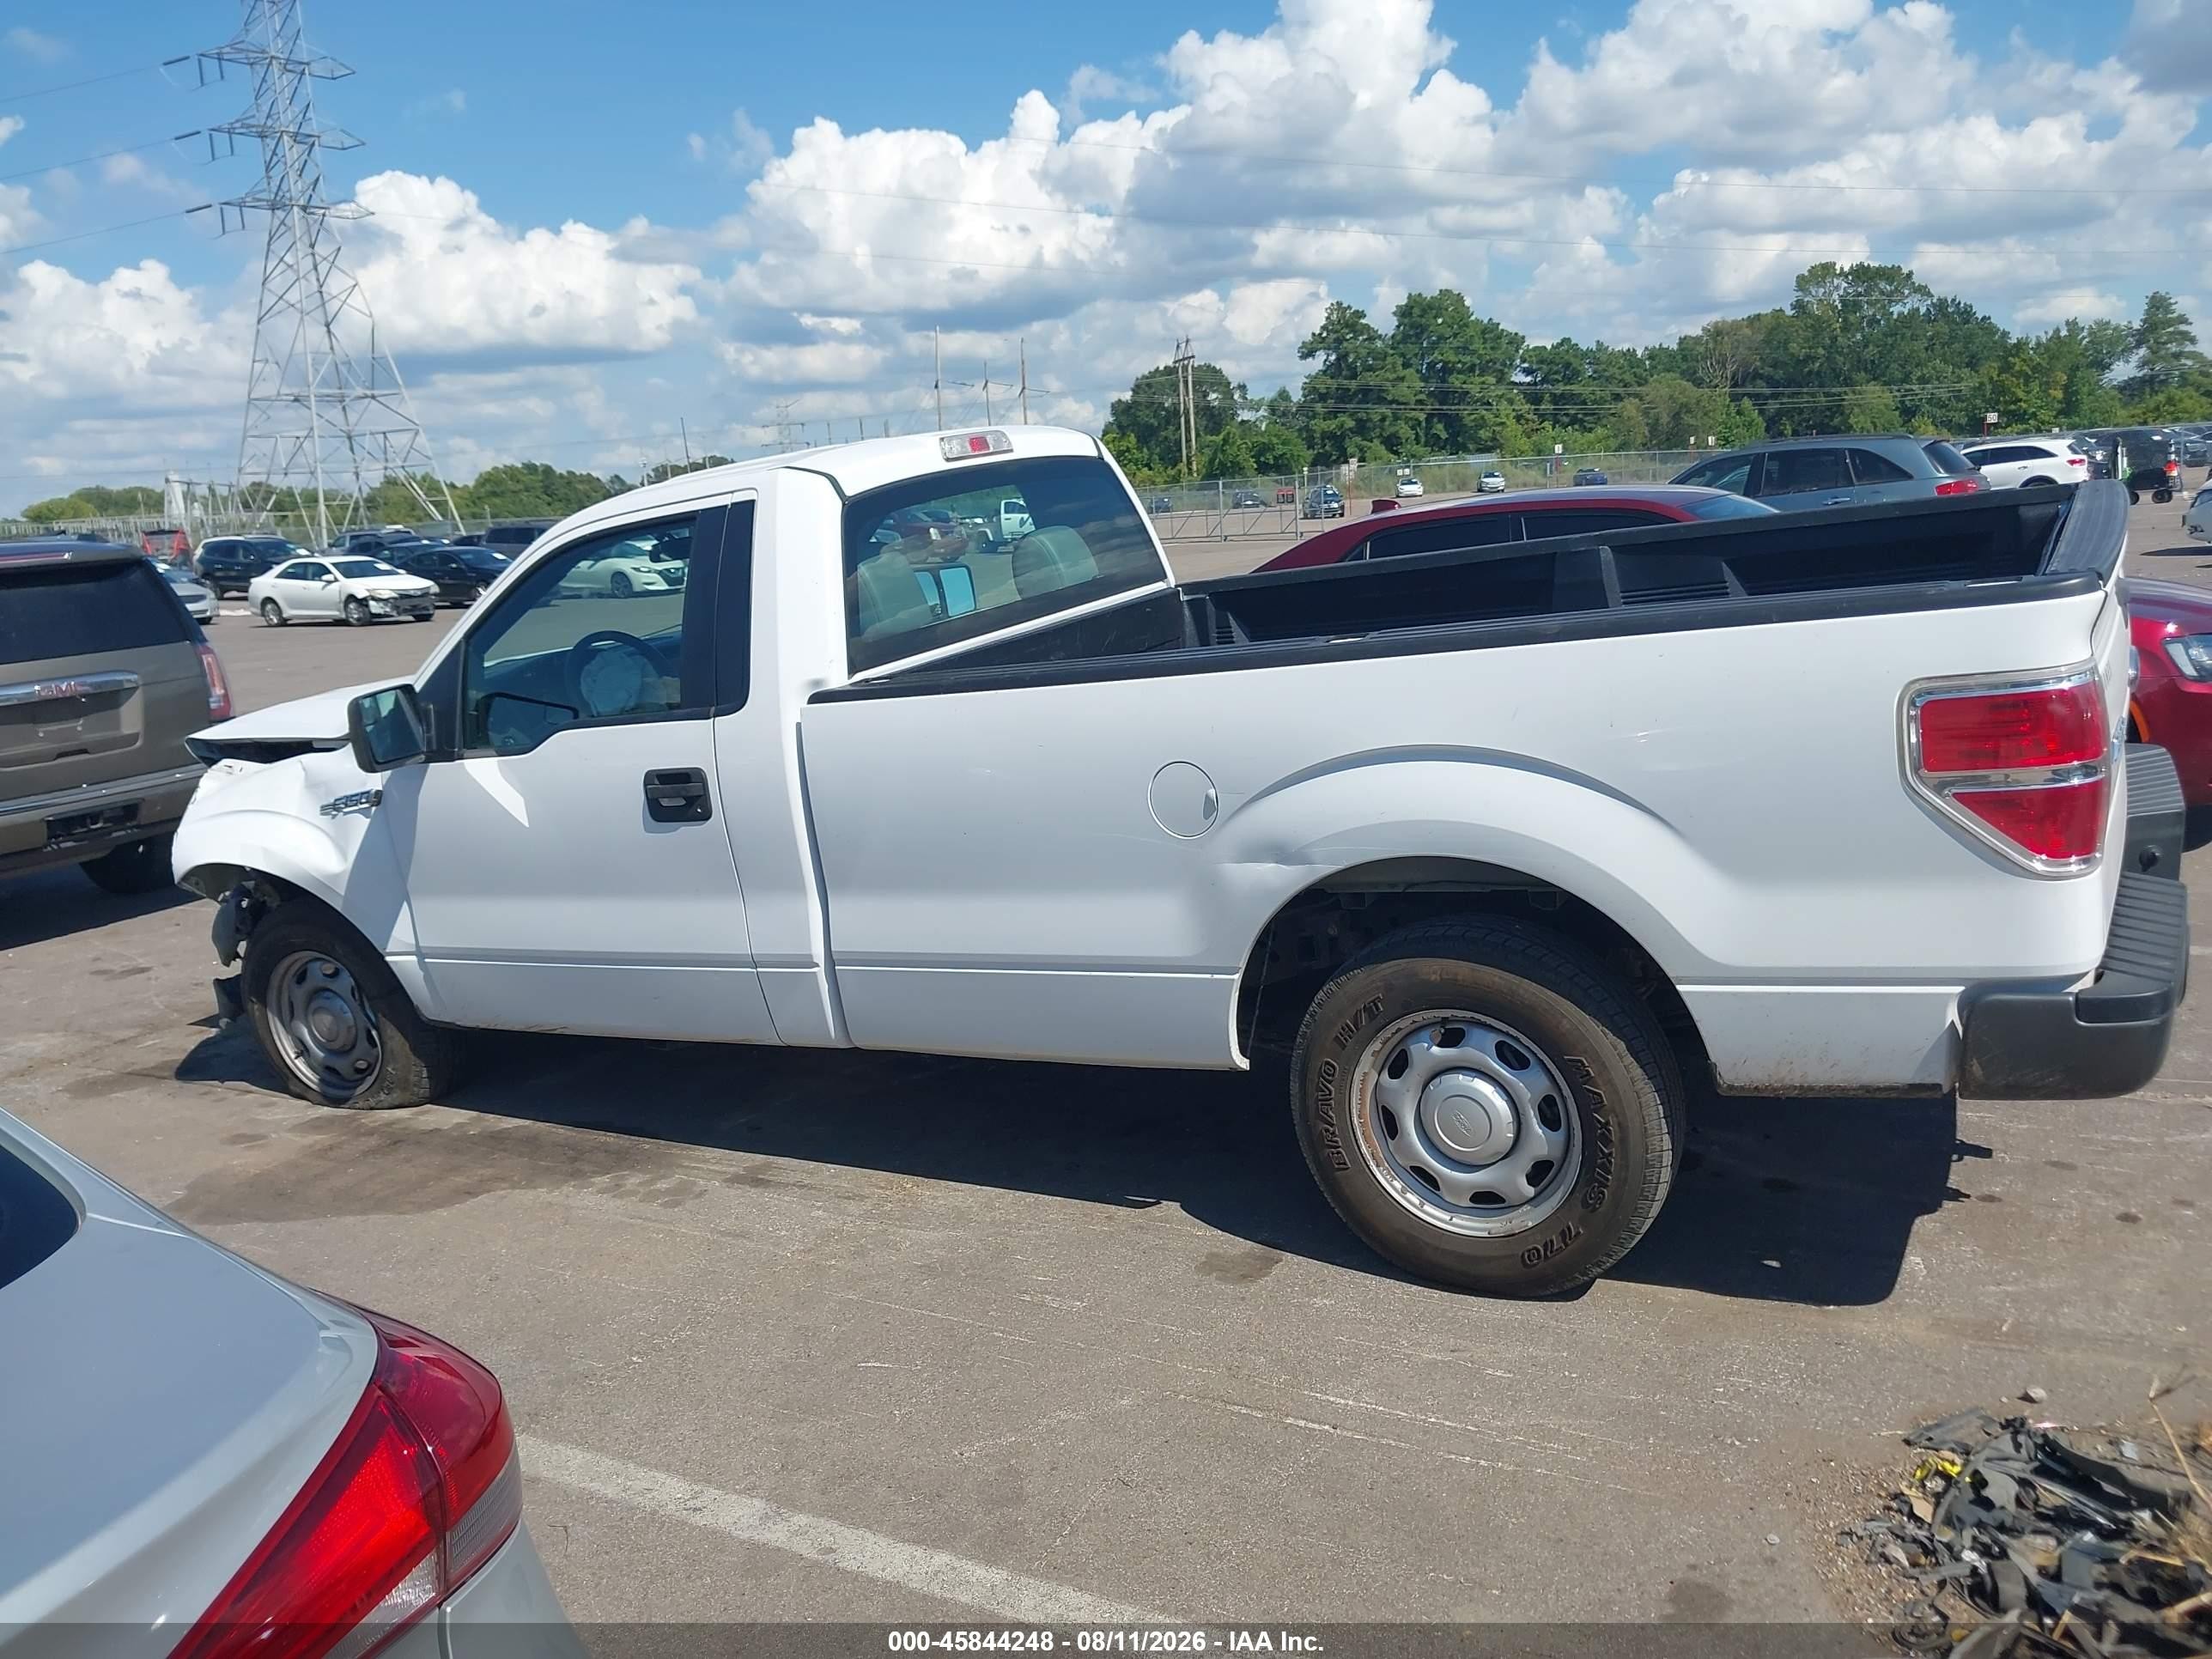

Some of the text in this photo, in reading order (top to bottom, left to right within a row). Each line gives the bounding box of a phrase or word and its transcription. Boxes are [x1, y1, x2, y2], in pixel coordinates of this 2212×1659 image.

[1317, 994, 1383, 1170] BRAVO H/T
[1522, 1055, 1614, 1268] MAXXIS 770
